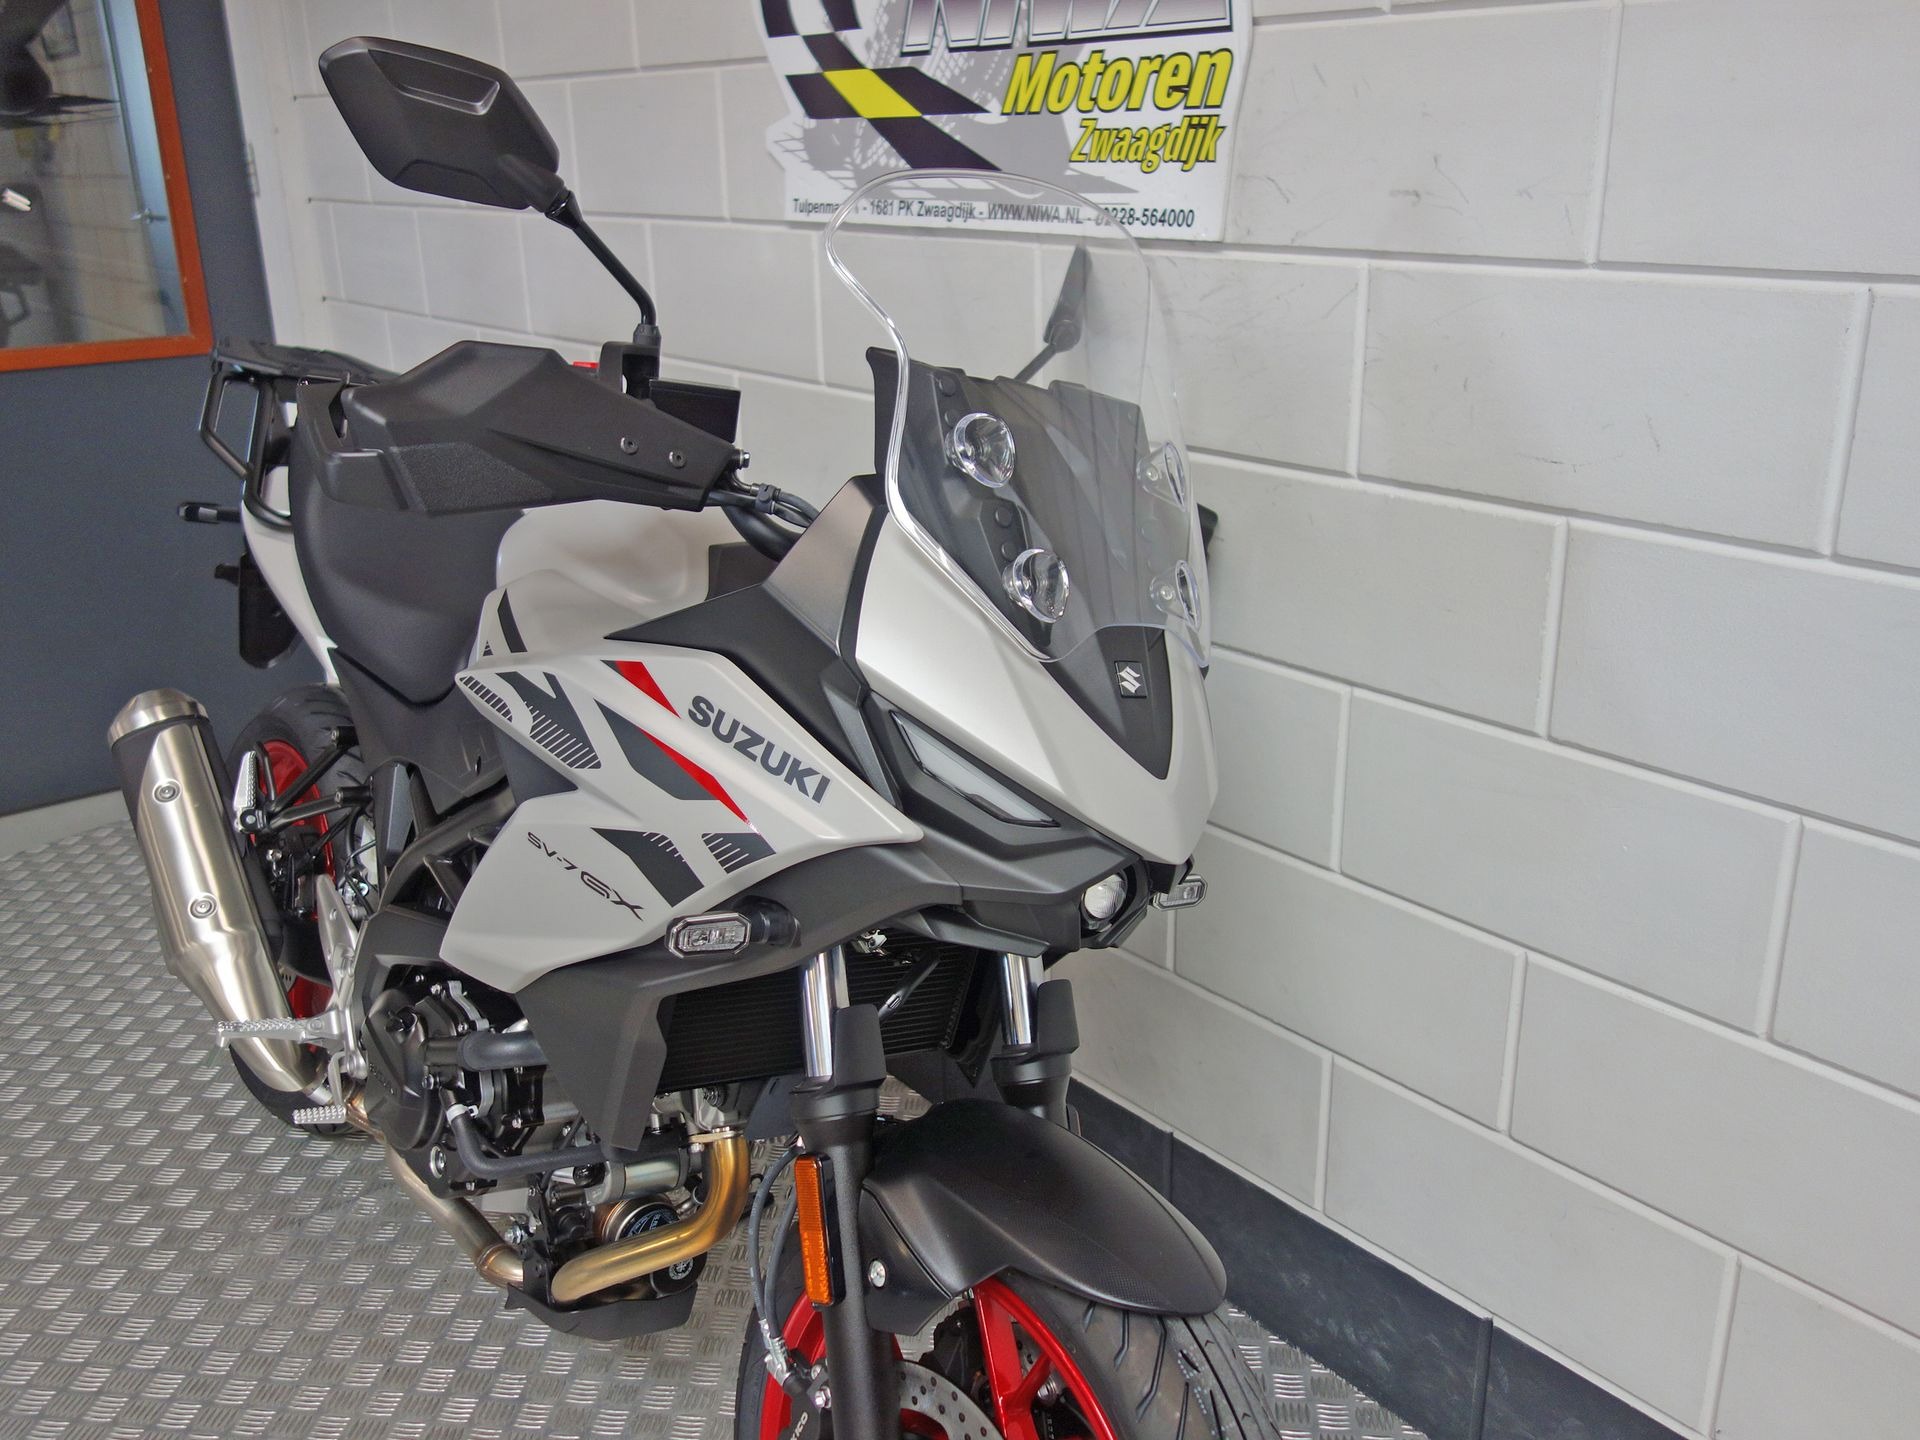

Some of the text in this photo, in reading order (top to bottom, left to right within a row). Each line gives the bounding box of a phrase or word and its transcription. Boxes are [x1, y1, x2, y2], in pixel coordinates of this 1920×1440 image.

[1000, 48, 1234, 115] Motoren
[1069, 114, 1227, 174] Zwaagdijk
[870, 200, 894, 216] 1681
[898, 200, 914, 217] PK
[917, 201, 976, 222] Zwaagdijk
[987, 203, 1084, 225] WWW.NIWA.NL
[687, 695, 831, 804] SUZUKI
